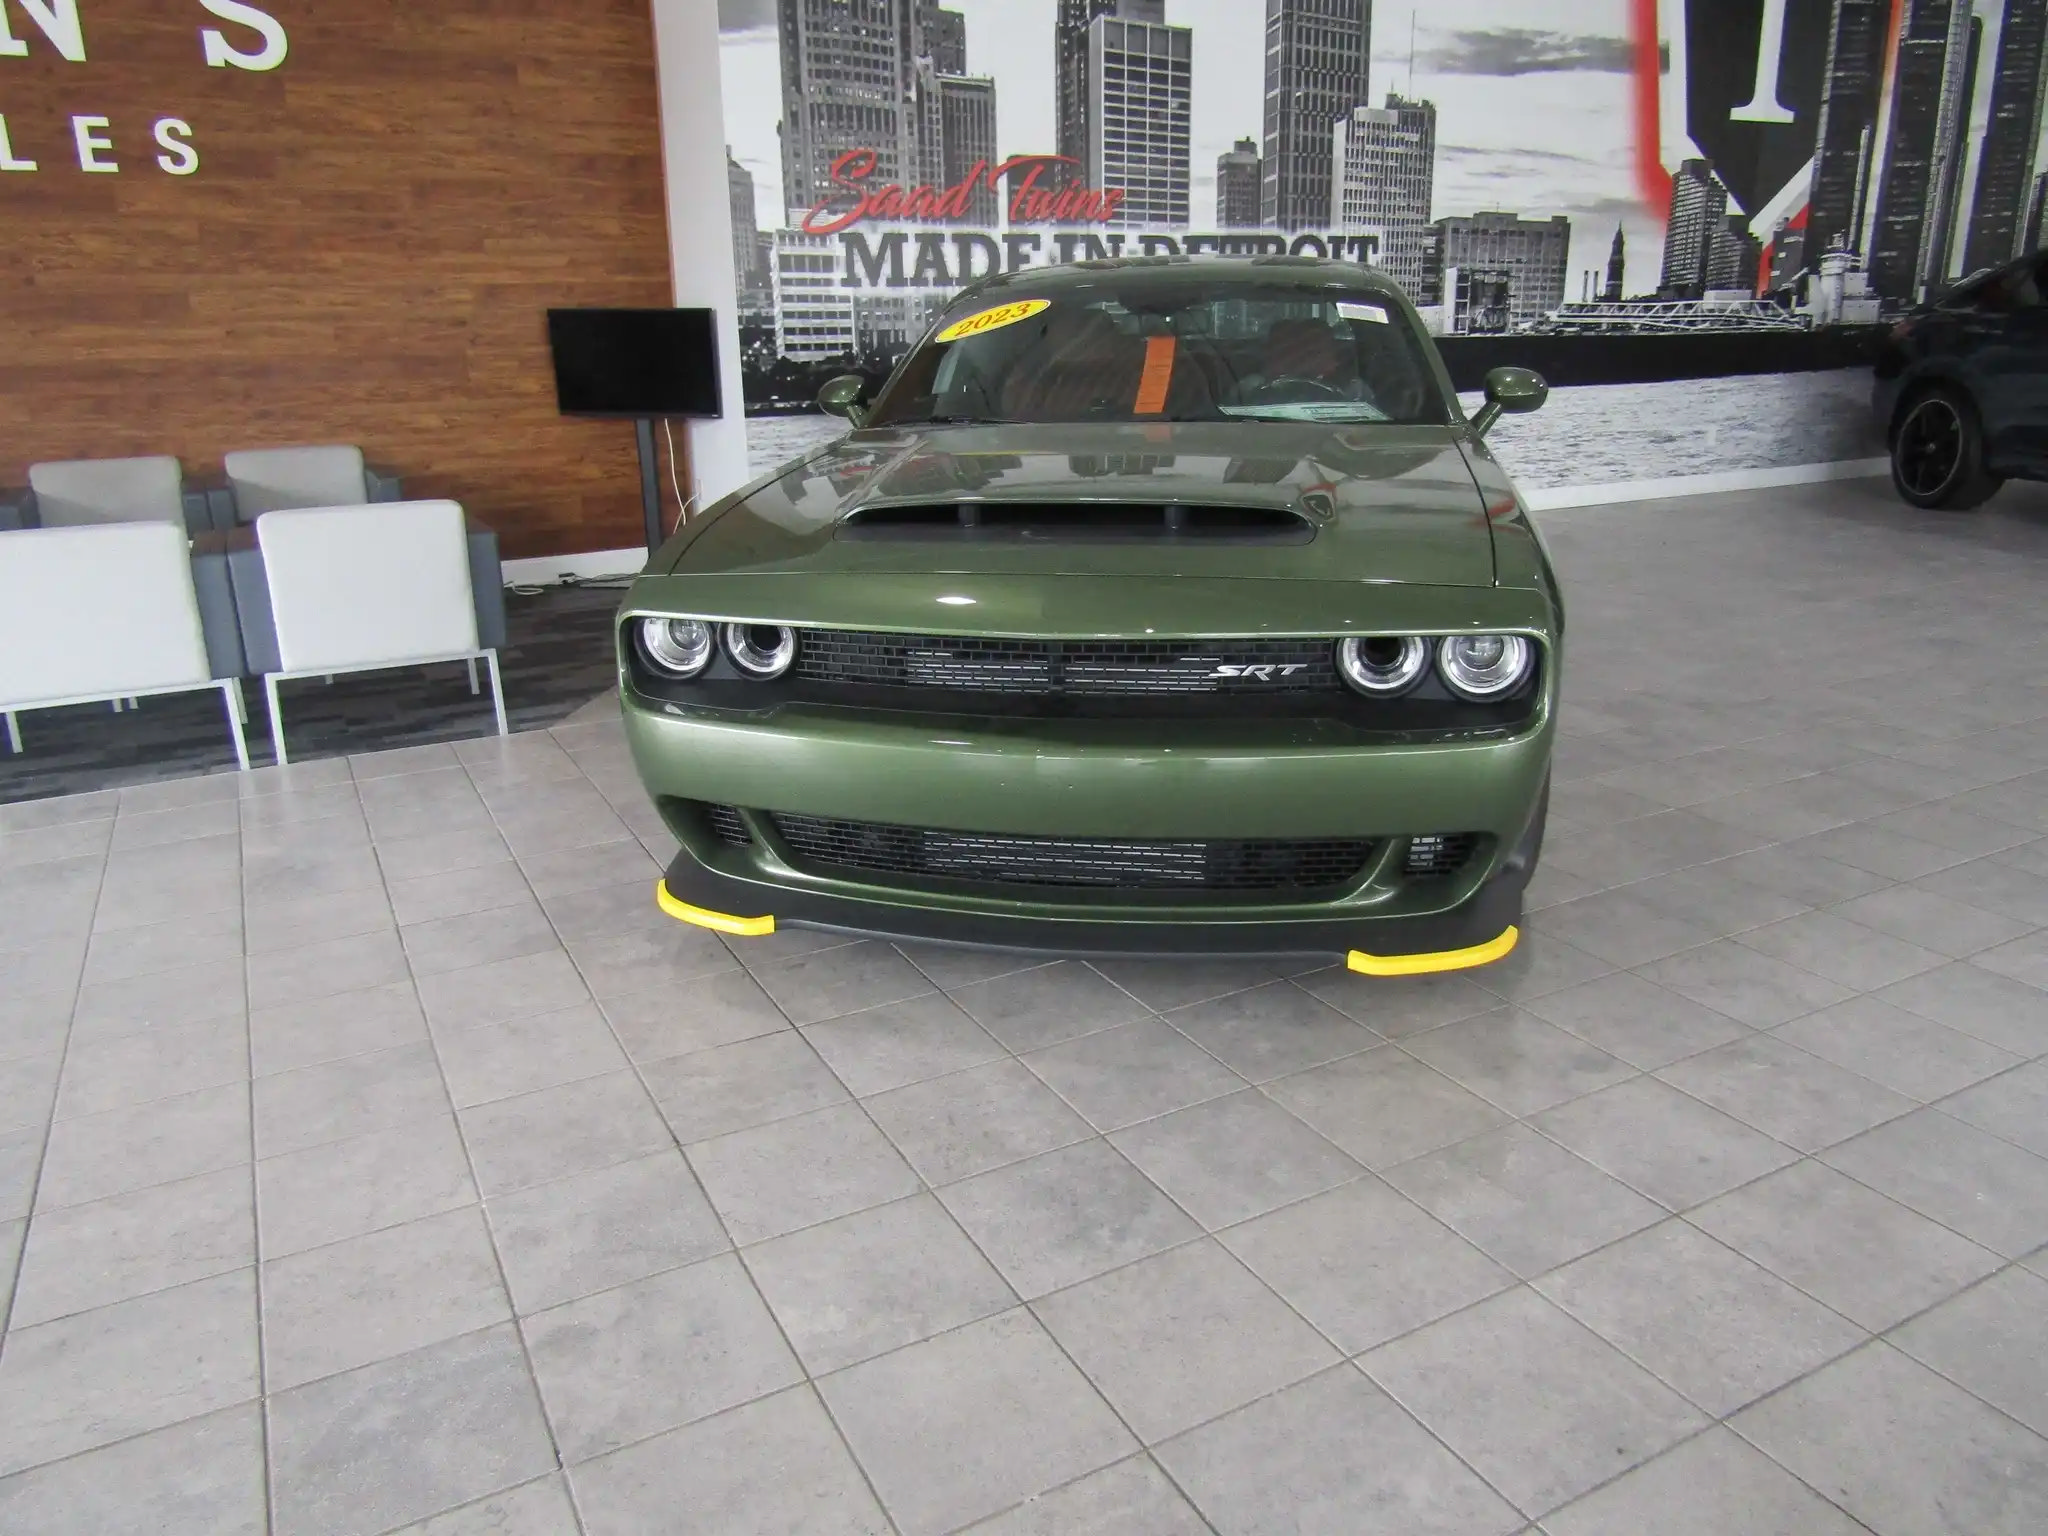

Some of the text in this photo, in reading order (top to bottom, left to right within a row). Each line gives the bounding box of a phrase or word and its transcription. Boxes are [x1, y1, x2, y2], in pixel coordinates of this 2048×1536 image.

[802, 148, 1125, 234] Saad Twins
[954, 303, 1031, 336] 2023
[1208, 663, 1308, 681] SRT
